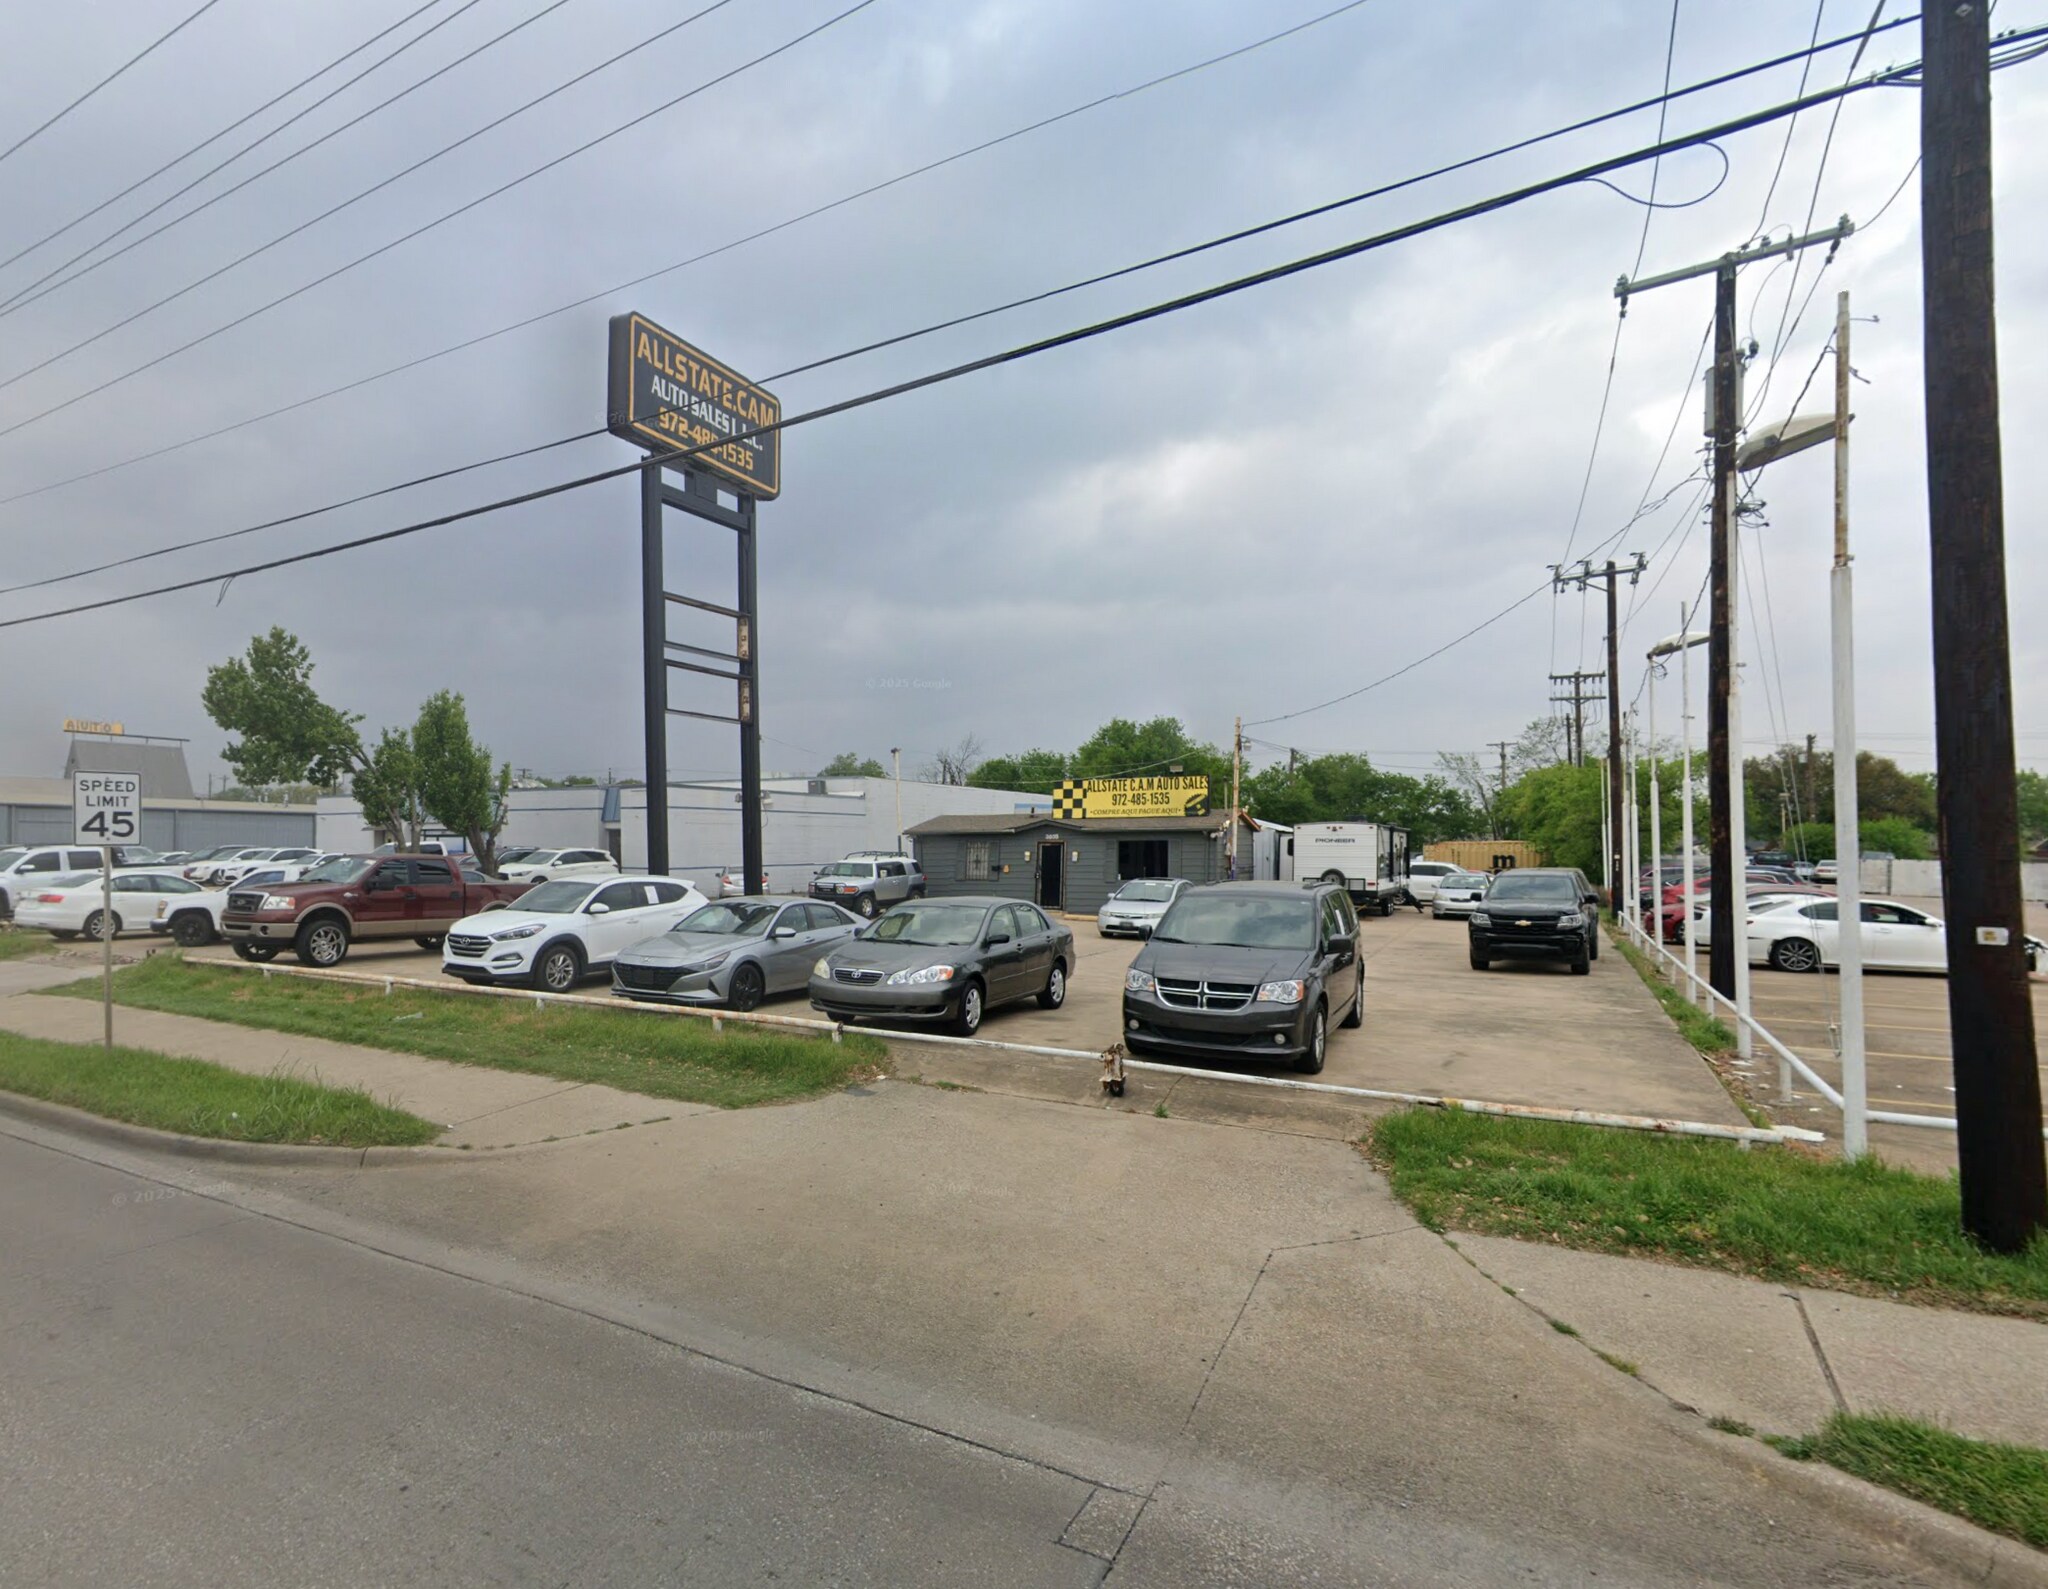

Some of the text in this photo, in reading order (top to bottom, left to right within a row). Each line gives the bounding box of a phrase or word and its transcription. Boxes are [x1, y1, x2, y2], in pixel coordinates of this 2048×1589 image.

[651, 374, 688, 411] AUTO
[691, 395, 730, 434] SALES
[66, 720, 112, 733] AUTO
[79, 780, 136, 792] SPEED
[1087, 779, 1128, 793] ALLSTATE
[1157, 777, 1181, 791] AUTO
[1182, 775, 1209, 790] SALES
[86, 796, 130, 807] LIMIT
[1112, 792, 1170, 807] 972-485-1535
[81, 811, 134, 837] 45
